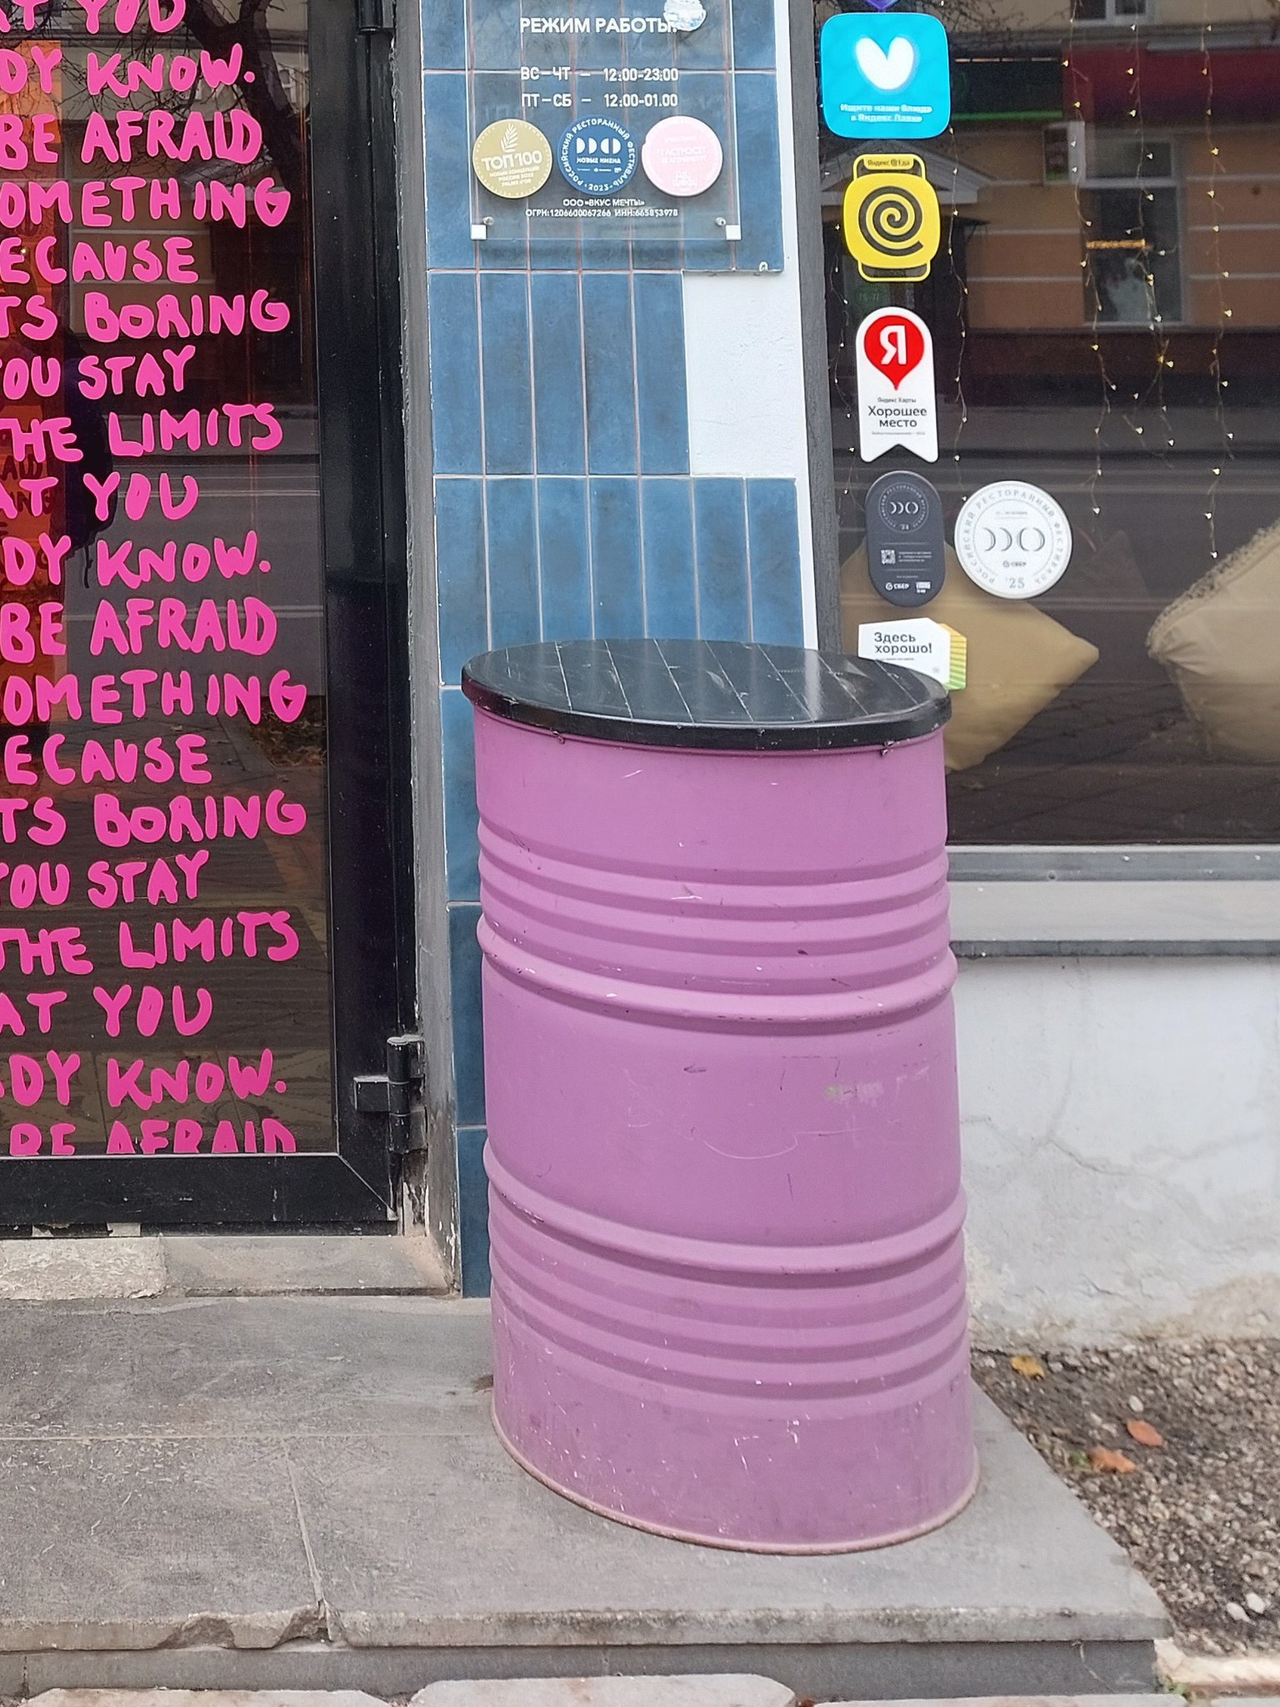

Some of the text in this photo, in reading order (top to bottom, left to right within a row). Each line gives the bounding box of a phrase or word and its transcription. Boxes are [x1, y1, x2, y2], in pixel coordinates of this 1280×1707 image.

[520, 17, 590, 33] РЕЖИМ
[87, 44, 255, 98] KNOW.
[603, 67, 679, 81] 12:00-23:00
[81, 109, 263, 164] AFRAID
[563, 199, 584, 207] ООО
[84, 289, 290, 342] BORING
[880, 325, 907, 365] Я
[78, 345, 196, 400] STAY
[108, 403, 283, 457] LIMITS
[868, 405, 927, 418] Хорошее
[879, 419, 917, 427] место
[83, 472, 199, 521] YOU
[97, 531, 271, 590] KNOW.
[90, 597, 277, 656] AFRAID
[874, 632, 916, 644] Здесь
[875, 643, 932, 655] хорошо!
[94, 789, 306, 847] BORING
[88, 849, 209, 908] STAY
[119, 911, 299, 969] LIMITS
[94, 984, 212, 1037] YOU
[107, 1049, 286, 1110] KNOW.
